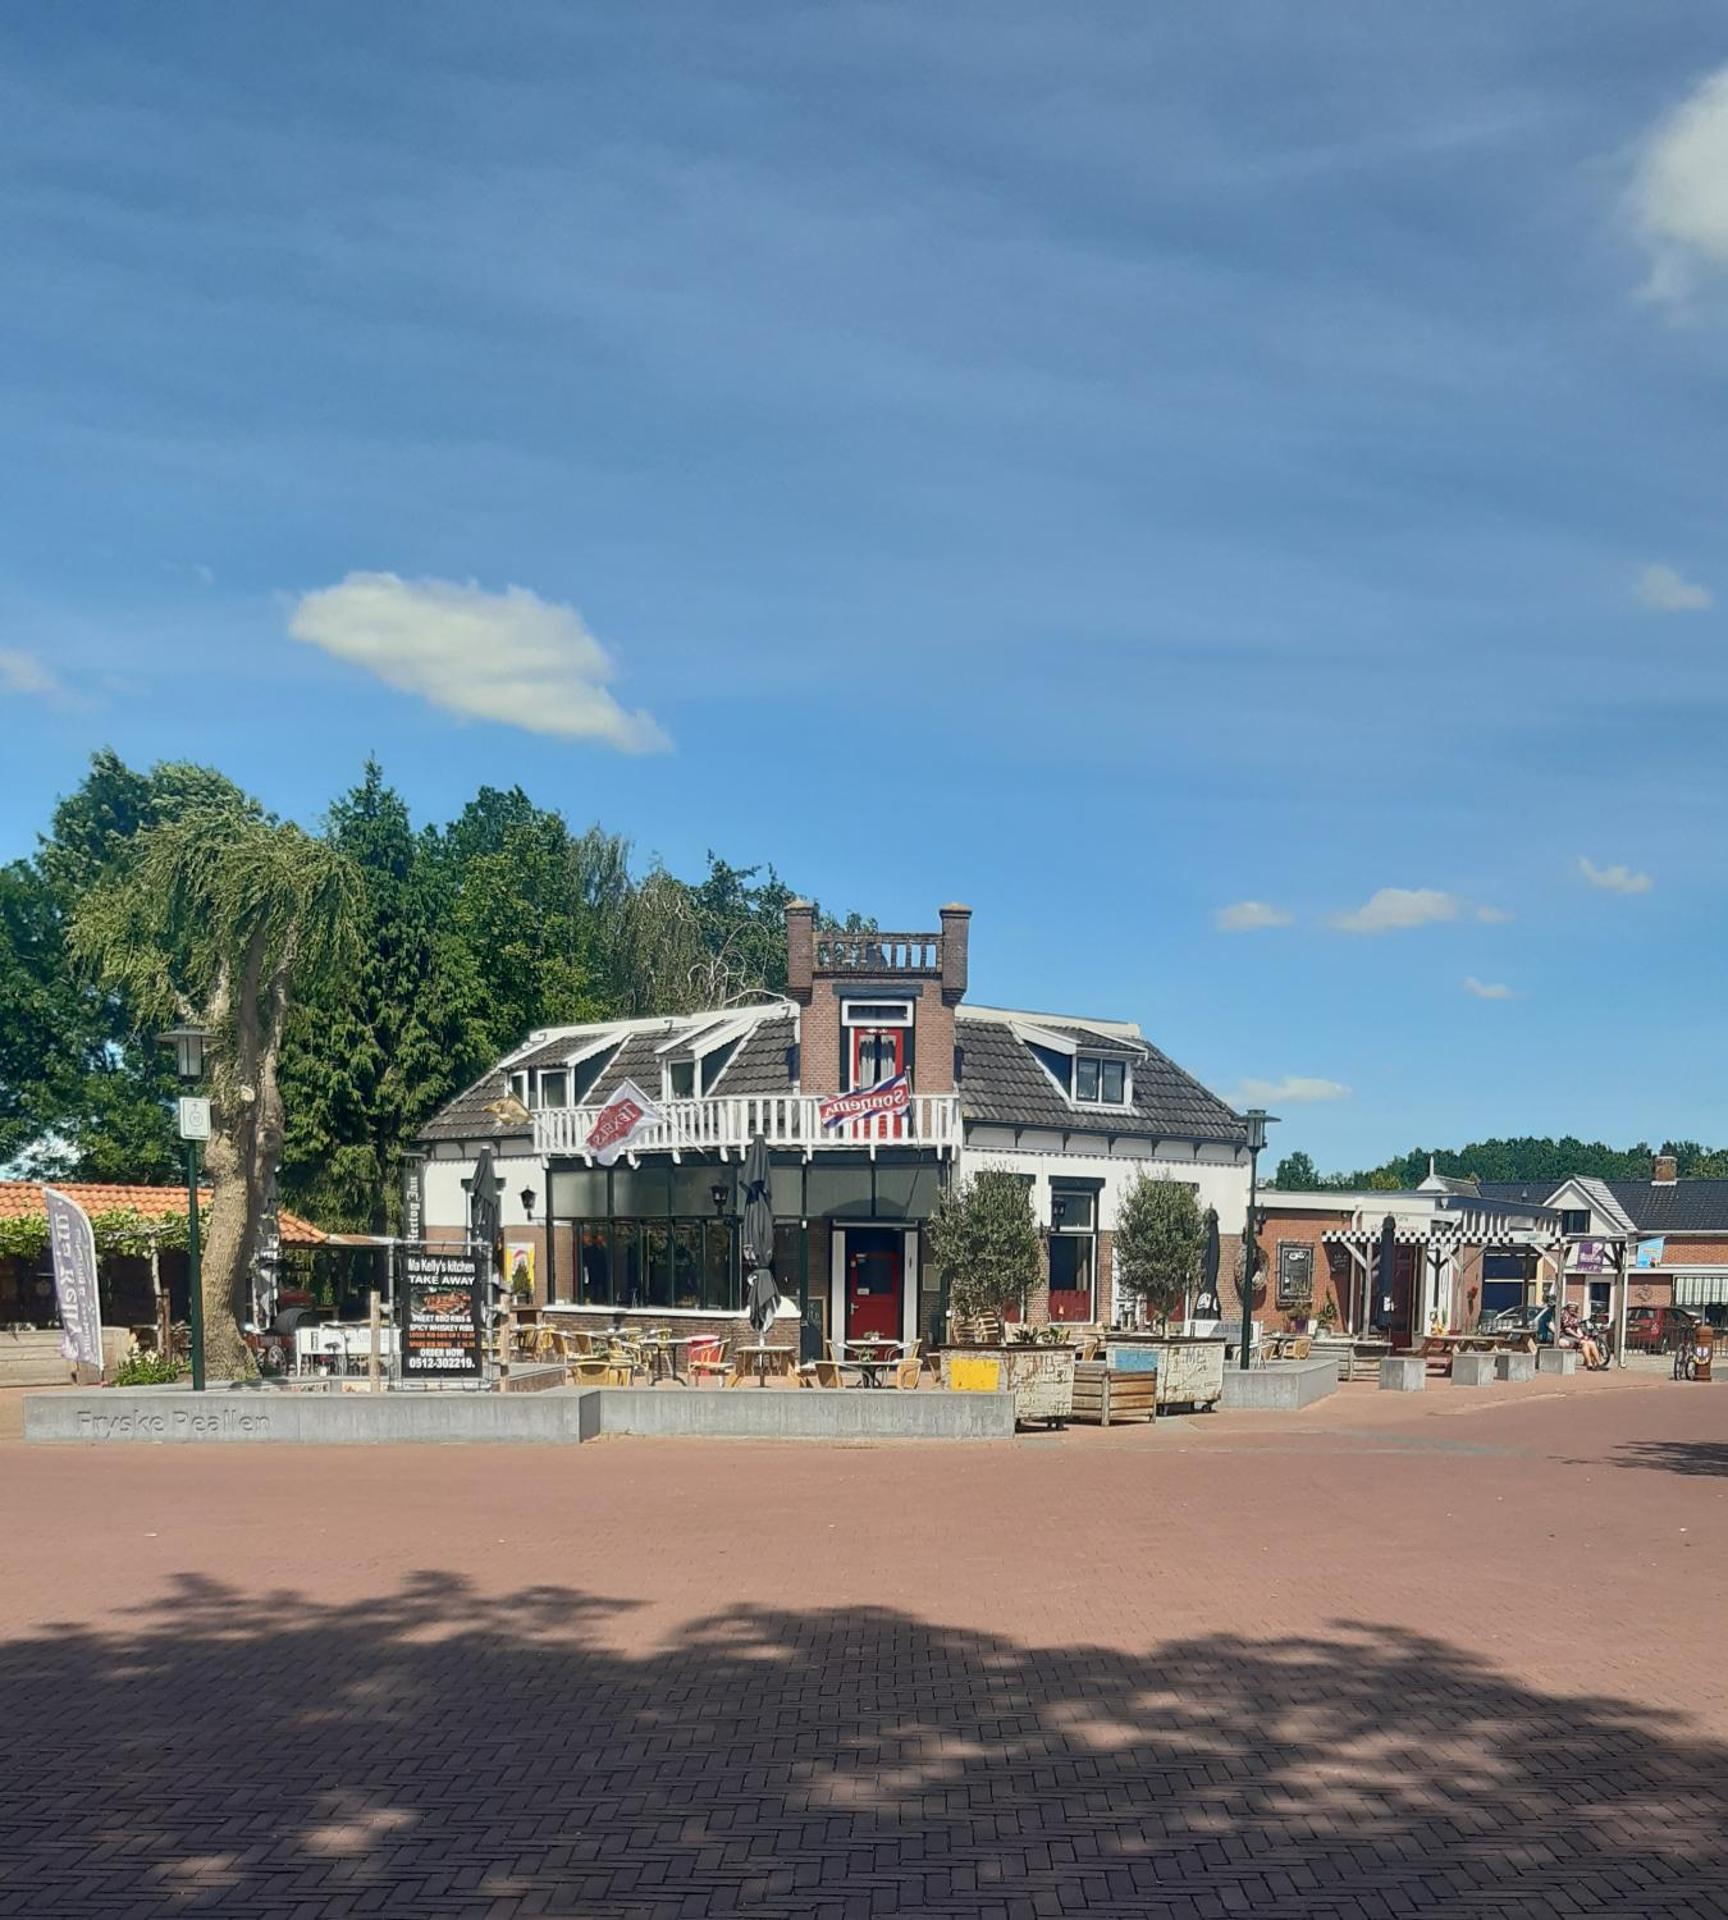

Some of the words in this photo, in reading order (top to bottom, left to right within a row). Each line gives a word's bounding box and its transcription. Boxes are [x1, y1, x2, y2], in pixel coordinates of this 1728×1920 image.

[421, 1258, 446, 1276] Kelly's
[408, 1275, 440, 1285] TAKE
[442, 1276, 476, 1286] AWAY
[420, 1348, 445, 1358] ORDER
[77, 1408, 165, 1439] Fryske
[172, 1408, 270, 1431] Peallen
